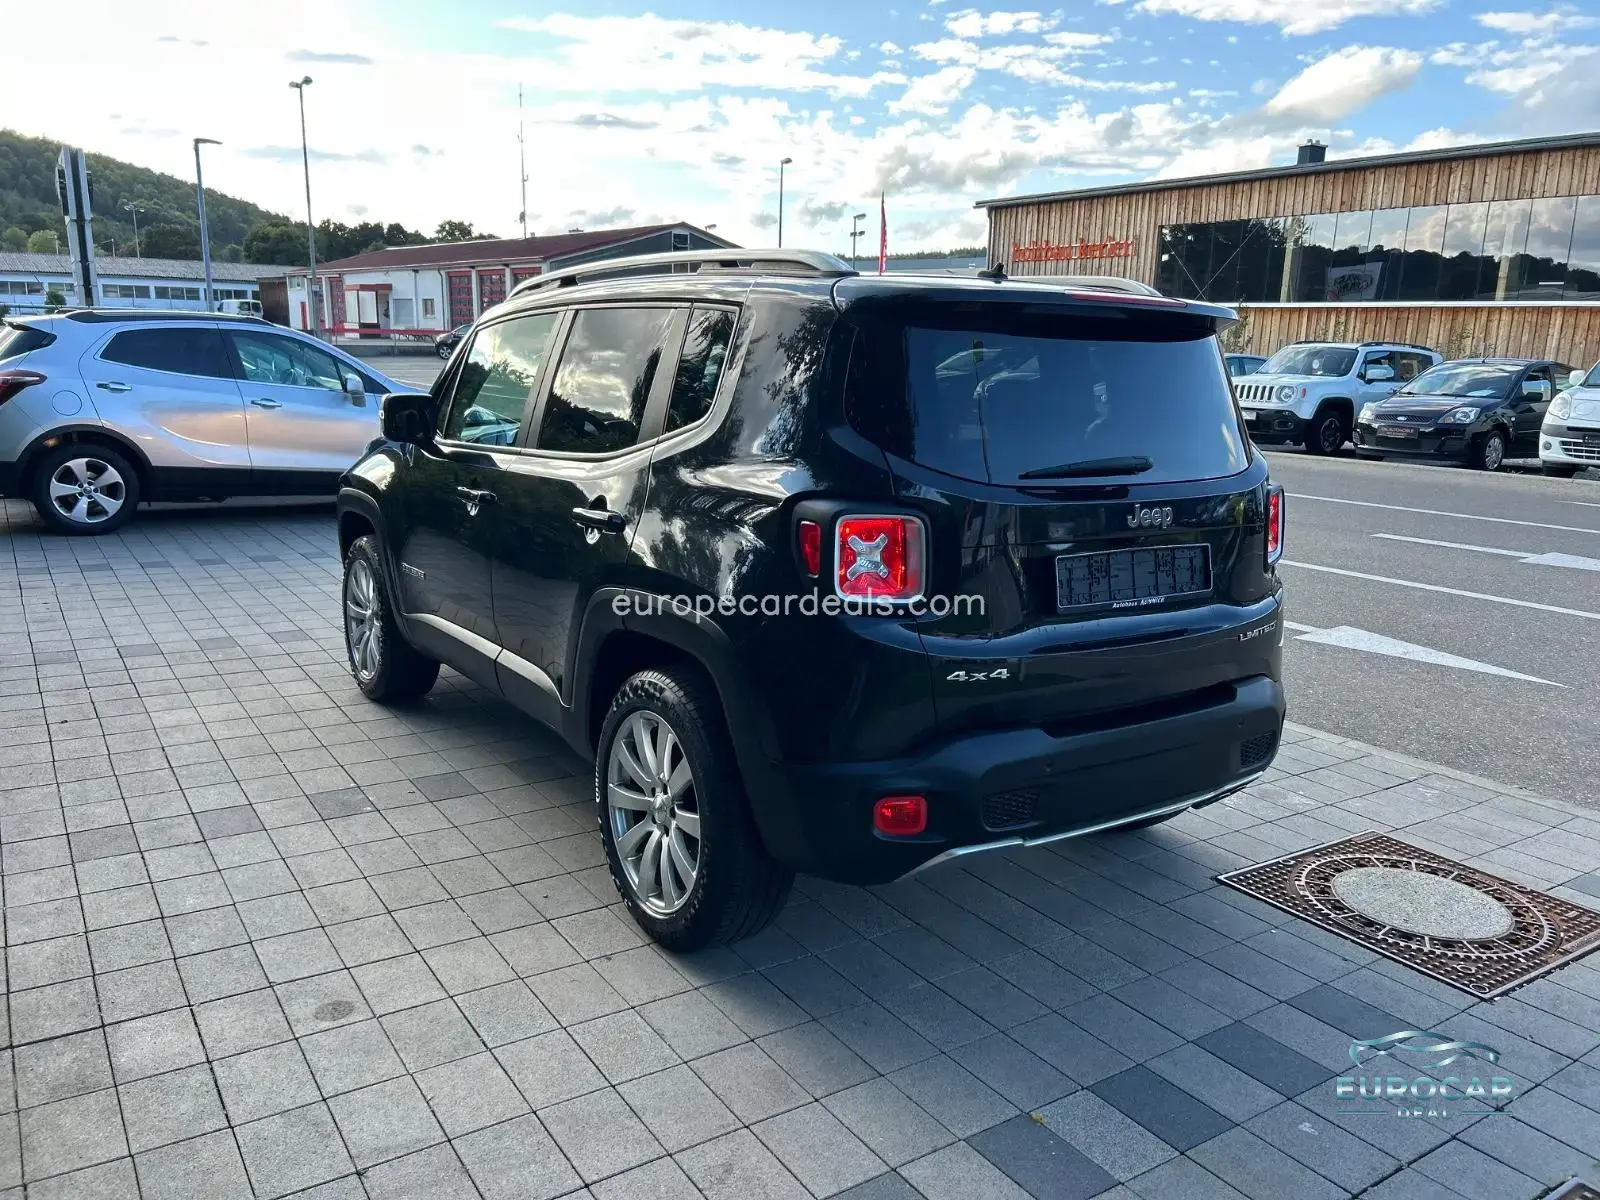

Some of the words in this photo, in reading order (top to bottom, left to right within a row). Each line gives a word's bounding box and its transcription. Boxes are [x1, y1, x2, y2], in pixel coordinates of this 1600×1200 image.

[1127, 504, 1173, 528] Jeep
[1239, 622, 1276, 642] LIMITED
[946, 668, 1011, 682] 4x4
